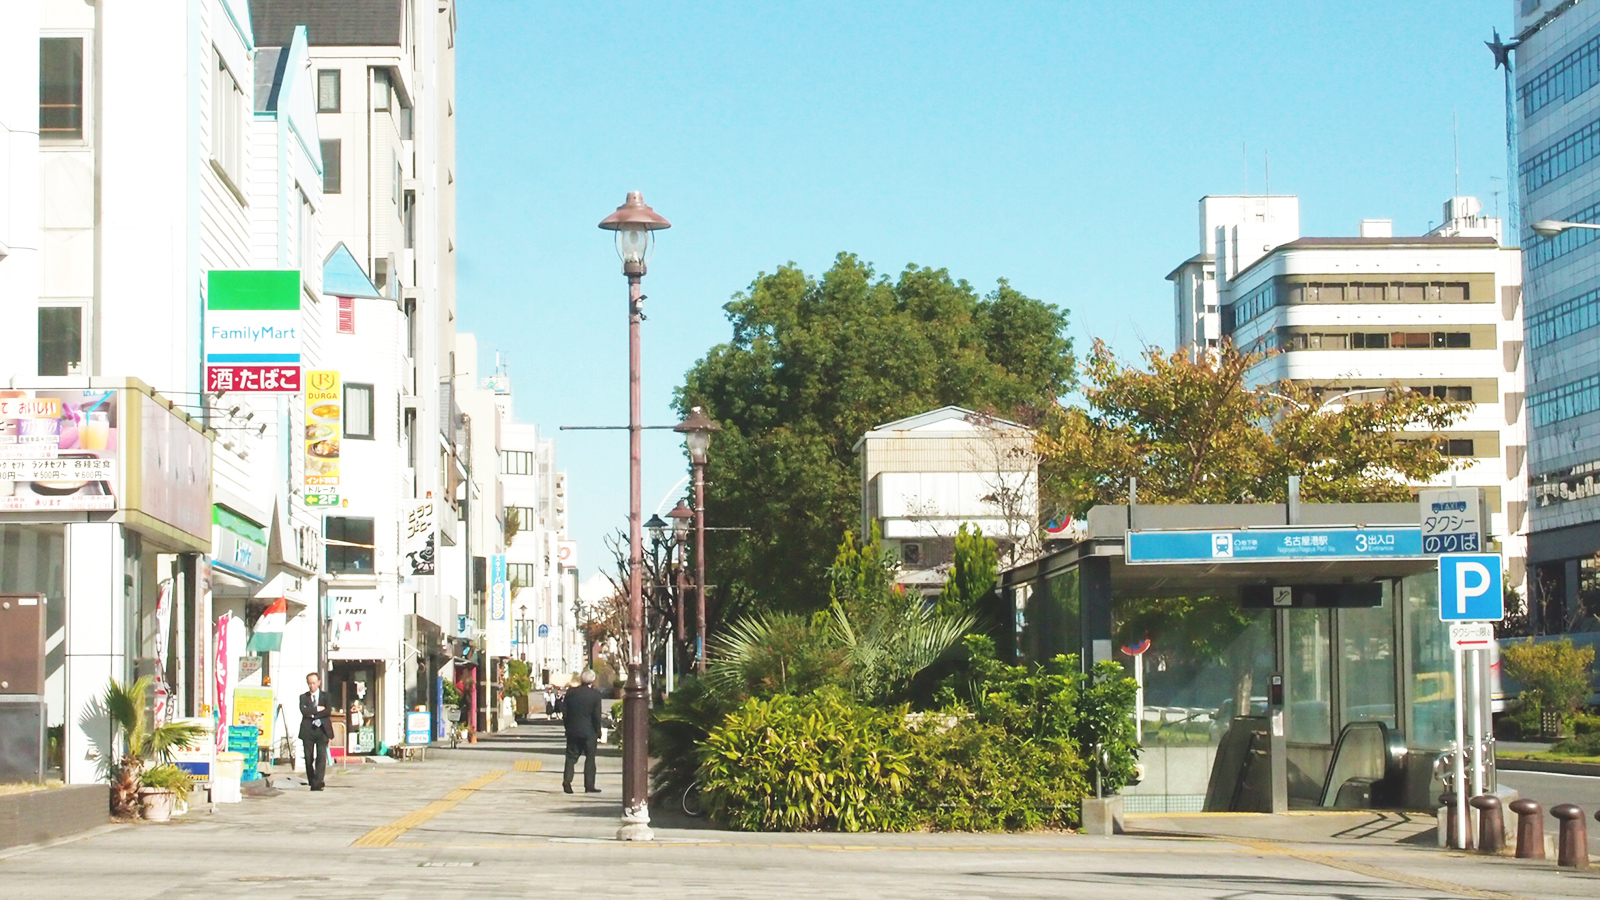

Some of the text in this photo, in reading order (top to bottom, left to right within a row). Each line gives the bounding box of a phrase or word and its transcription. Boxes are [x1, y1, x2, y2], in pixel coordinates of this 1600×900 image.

[211, 326, 295, 342] FamilyMart
[210, 367, 297, 390] 酒・たばこ
[308, 392, 337, 400] DURGA
[18, 402, 57, 415] おいしい
[74, 460, 111, 469] 各種定食
[318, 495, 336, 504] 2F
[1440, 501, 1458, 511] TAXI
[1424, 516, 1476, 533] タクシー
[1283, 535, 1329, 546] 名古屋港駅
[1355, 534, 1368, 552] 3
[1367, 534, 1395, 545] 出入口
[1425, 533, 1478, 553] のりば
[1456, 562, 1492, 614] P
[345, 608, 367, 616] PASTA
[344, 621, 362, 632] AT
